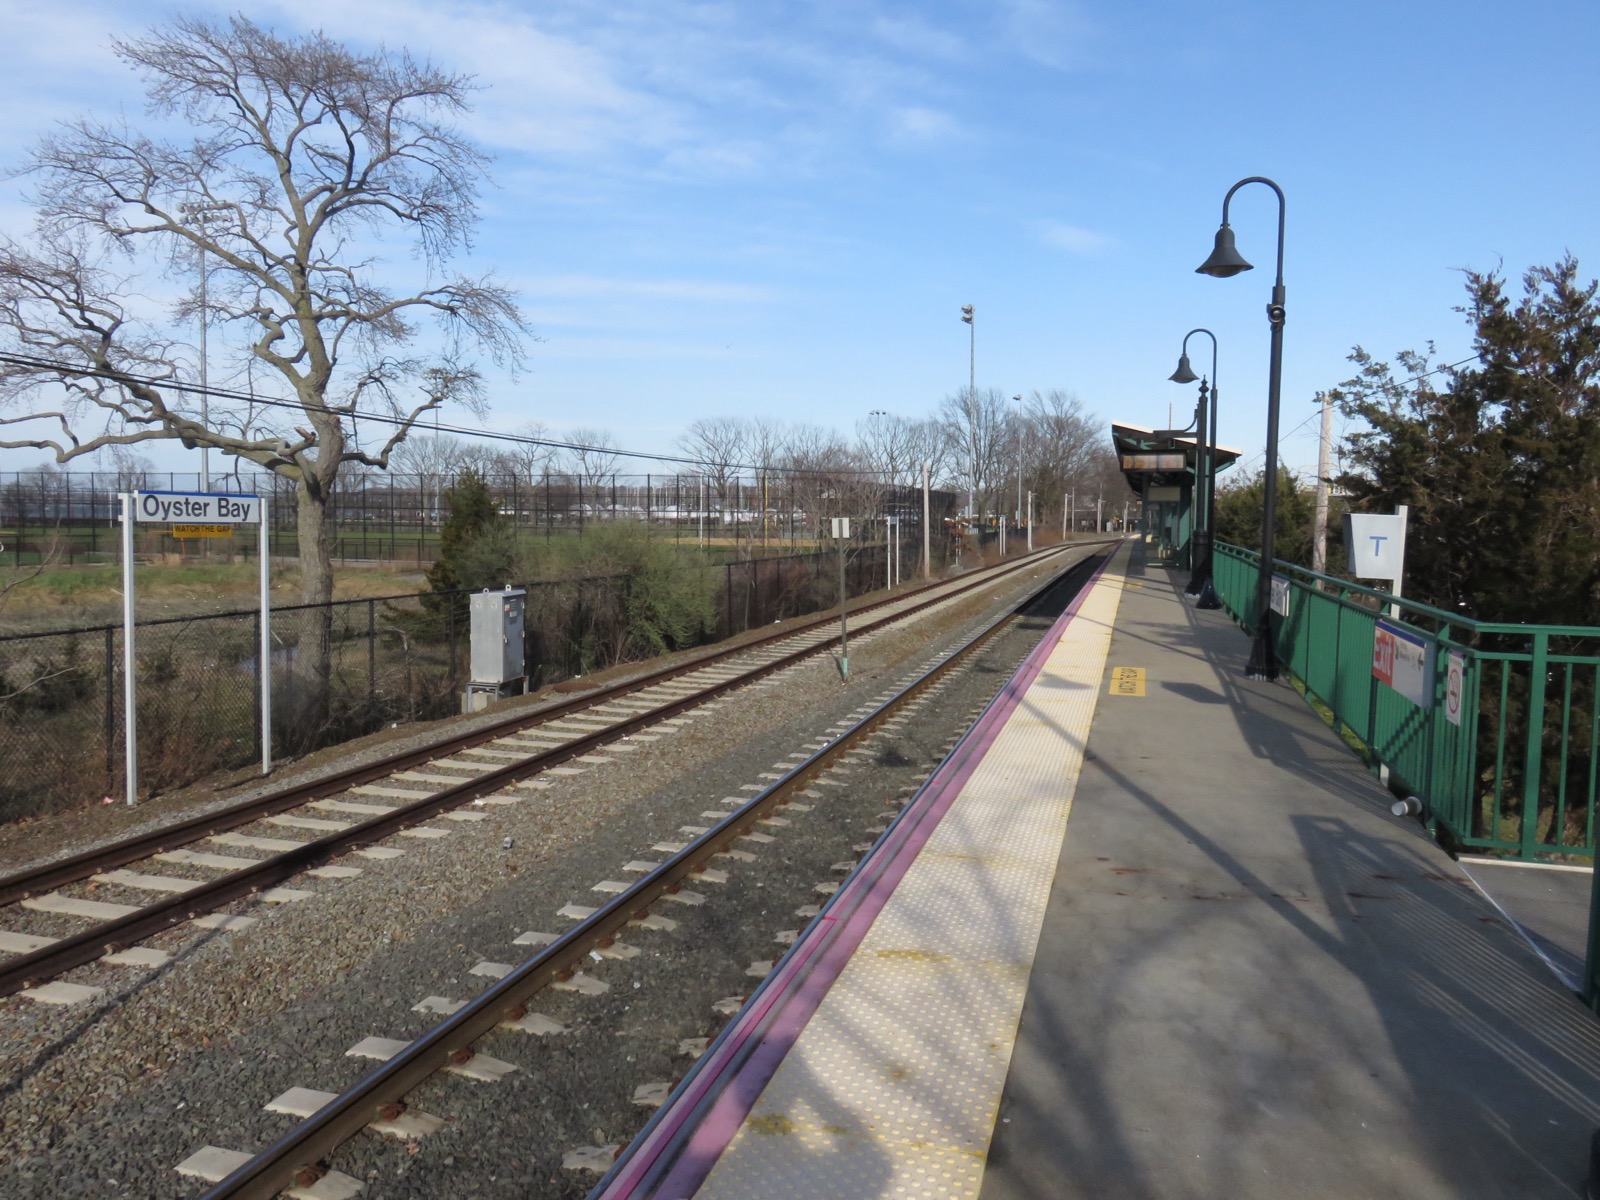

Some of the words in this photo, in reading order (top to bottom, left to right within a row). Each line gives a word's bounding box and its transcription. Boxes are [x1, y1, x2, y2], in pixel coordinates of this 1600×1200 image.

[143, 494, 209, 520] Oyster
[217, 498, 251, 521] Bay
[175, 525, 200, 533] WATCH
[216, 525, 231, 533] GAP
[1369, 536, 1387, 556] T
[1374, 629, 1392, 676] Exit
